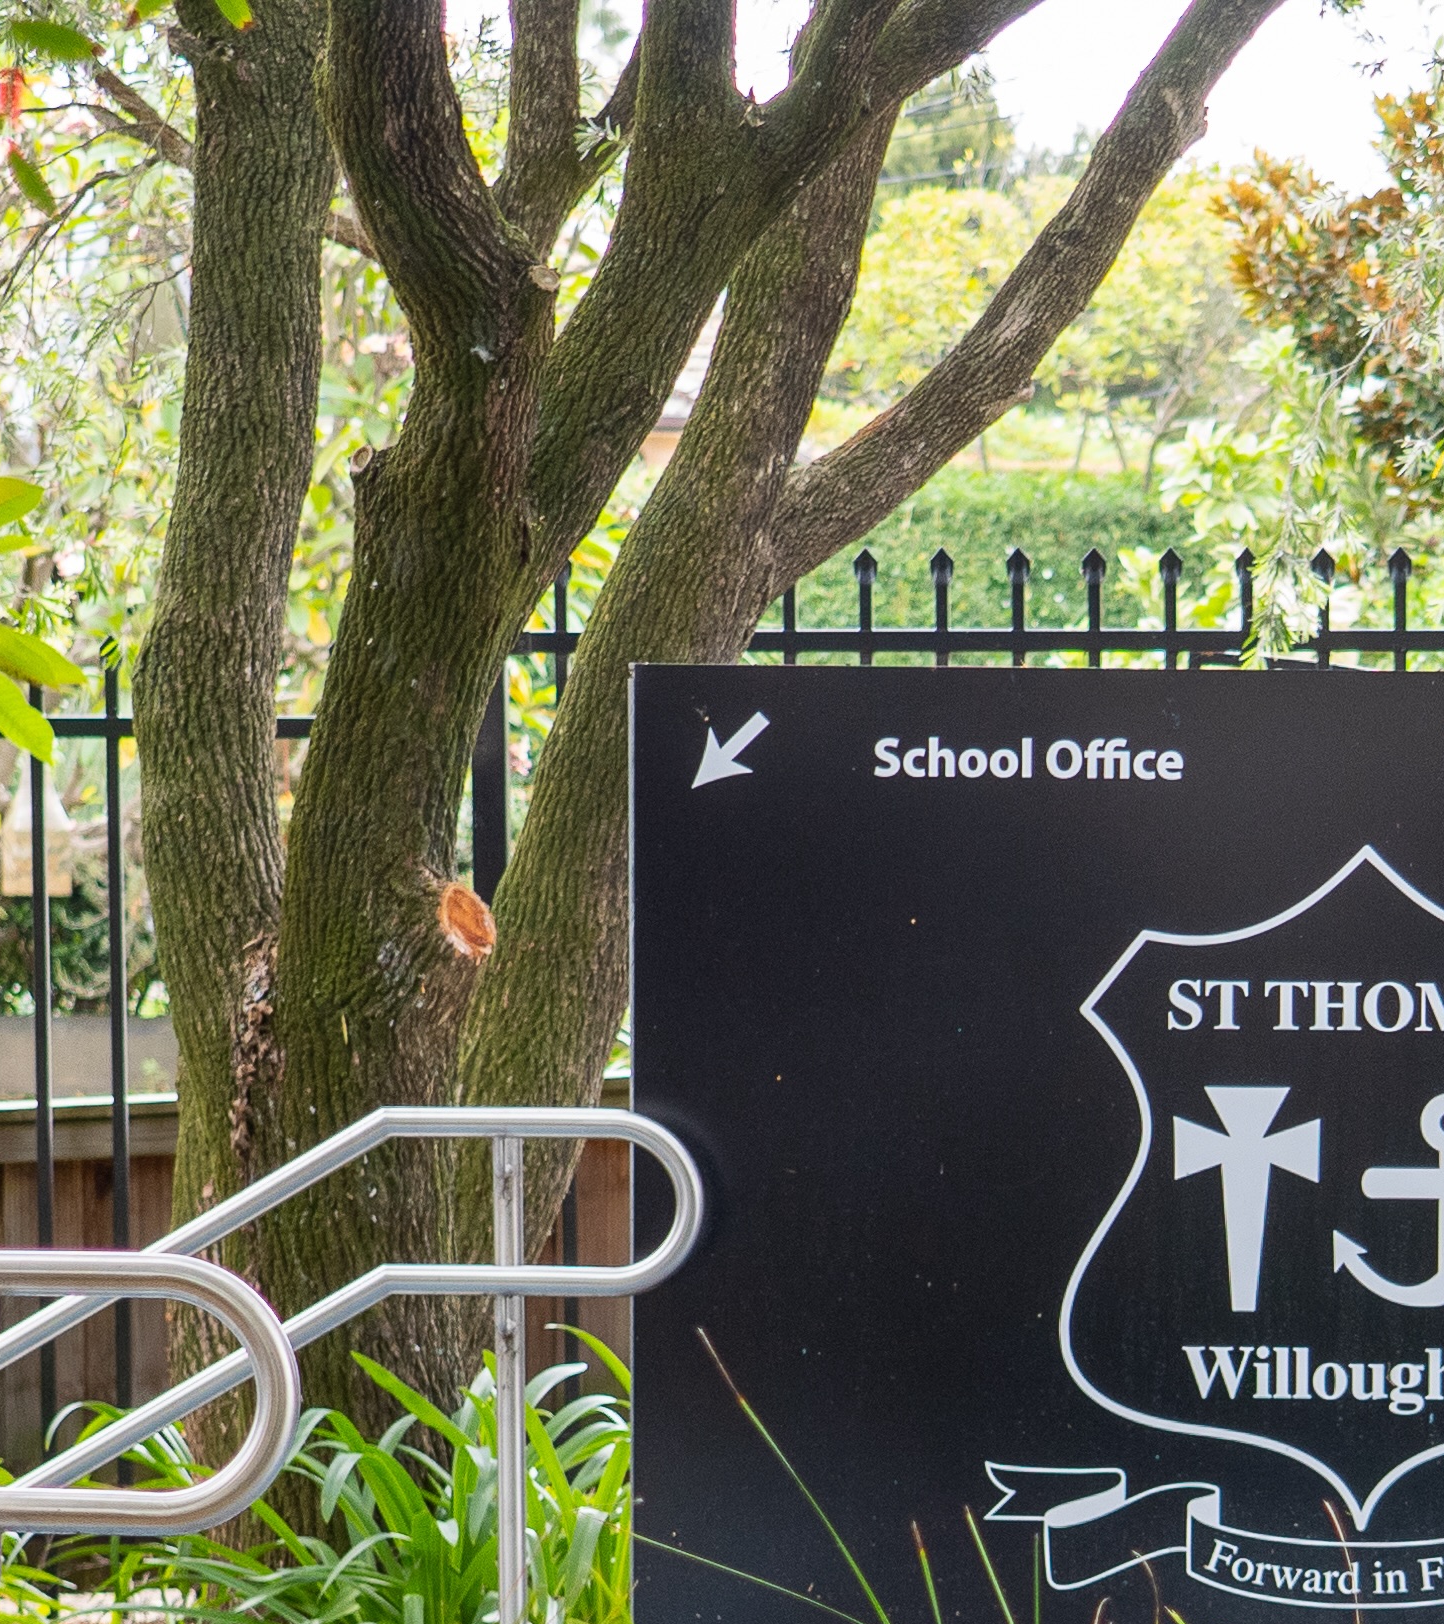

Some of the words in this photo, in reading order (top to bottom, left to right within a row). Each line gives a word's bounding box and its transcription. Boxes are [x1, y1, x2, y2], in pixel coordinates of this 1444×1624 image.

[873, 736, 1033, 779] School
[1045, 737, 1185, 781] Office
[1167, 978, 1250, 1031] ST
[1203, 1538, 1359, 1596] Forward
[1372, 1560, 1409, 1595] in
